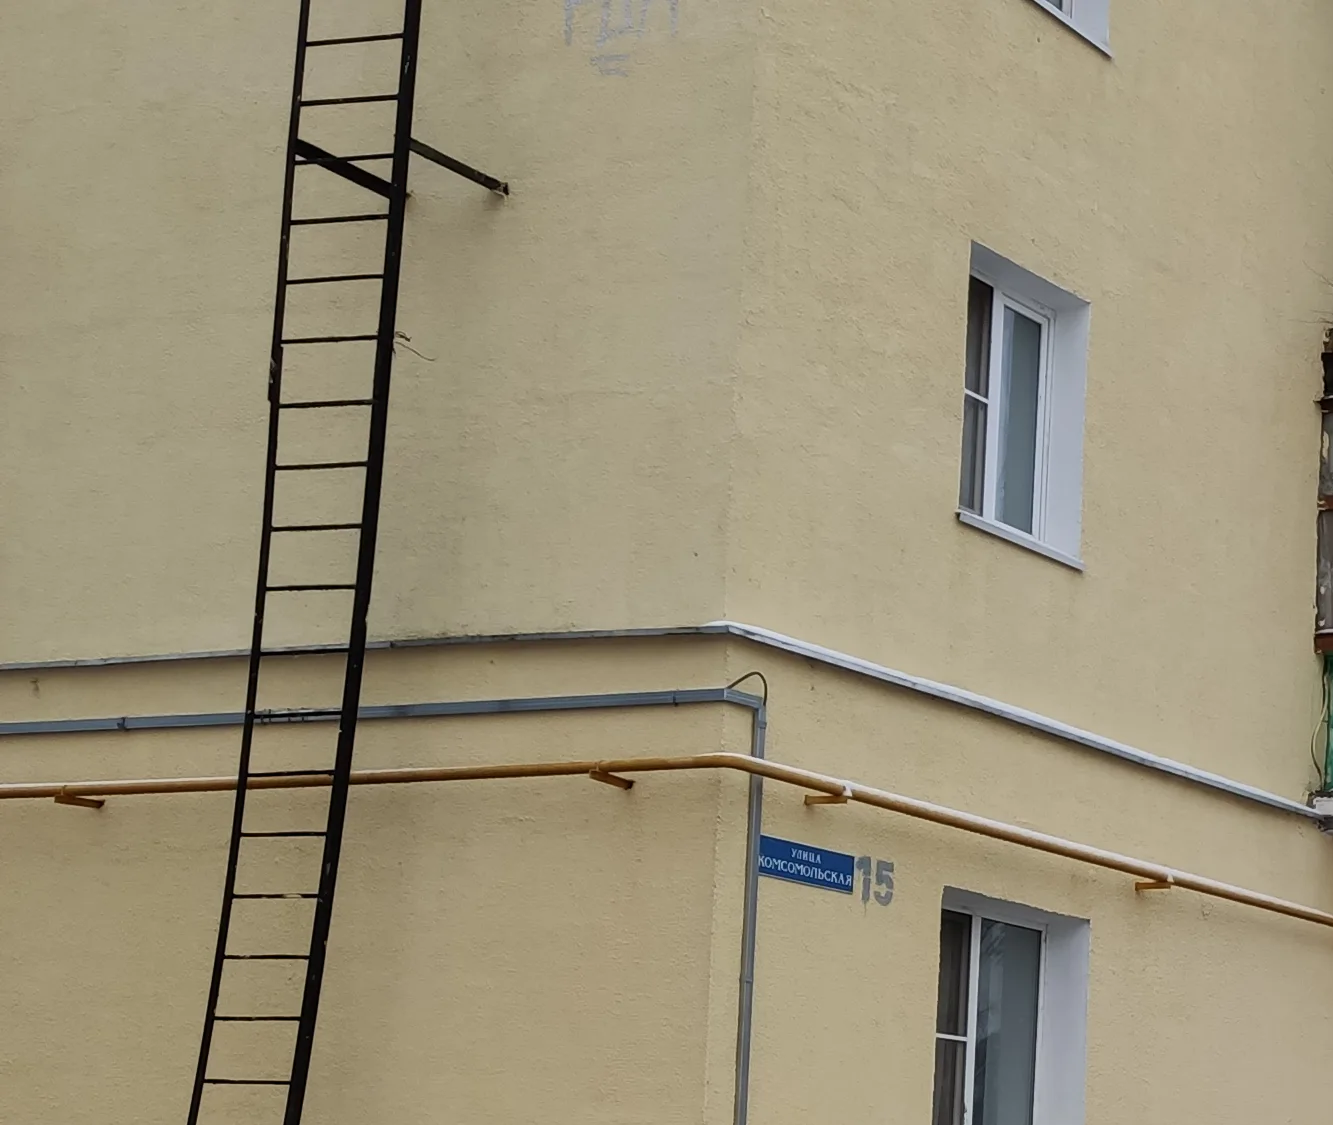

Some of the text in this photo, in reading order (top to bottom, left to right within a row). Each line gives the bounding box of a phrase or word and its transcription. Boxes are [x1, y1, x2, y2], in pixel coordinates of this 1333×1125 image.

[758, 855, 853, 887] КОМСОМОЛЬСКАЯ
[791, 847, 822, 865] УЛИЦА
[856, 855, 895, 907] 15
